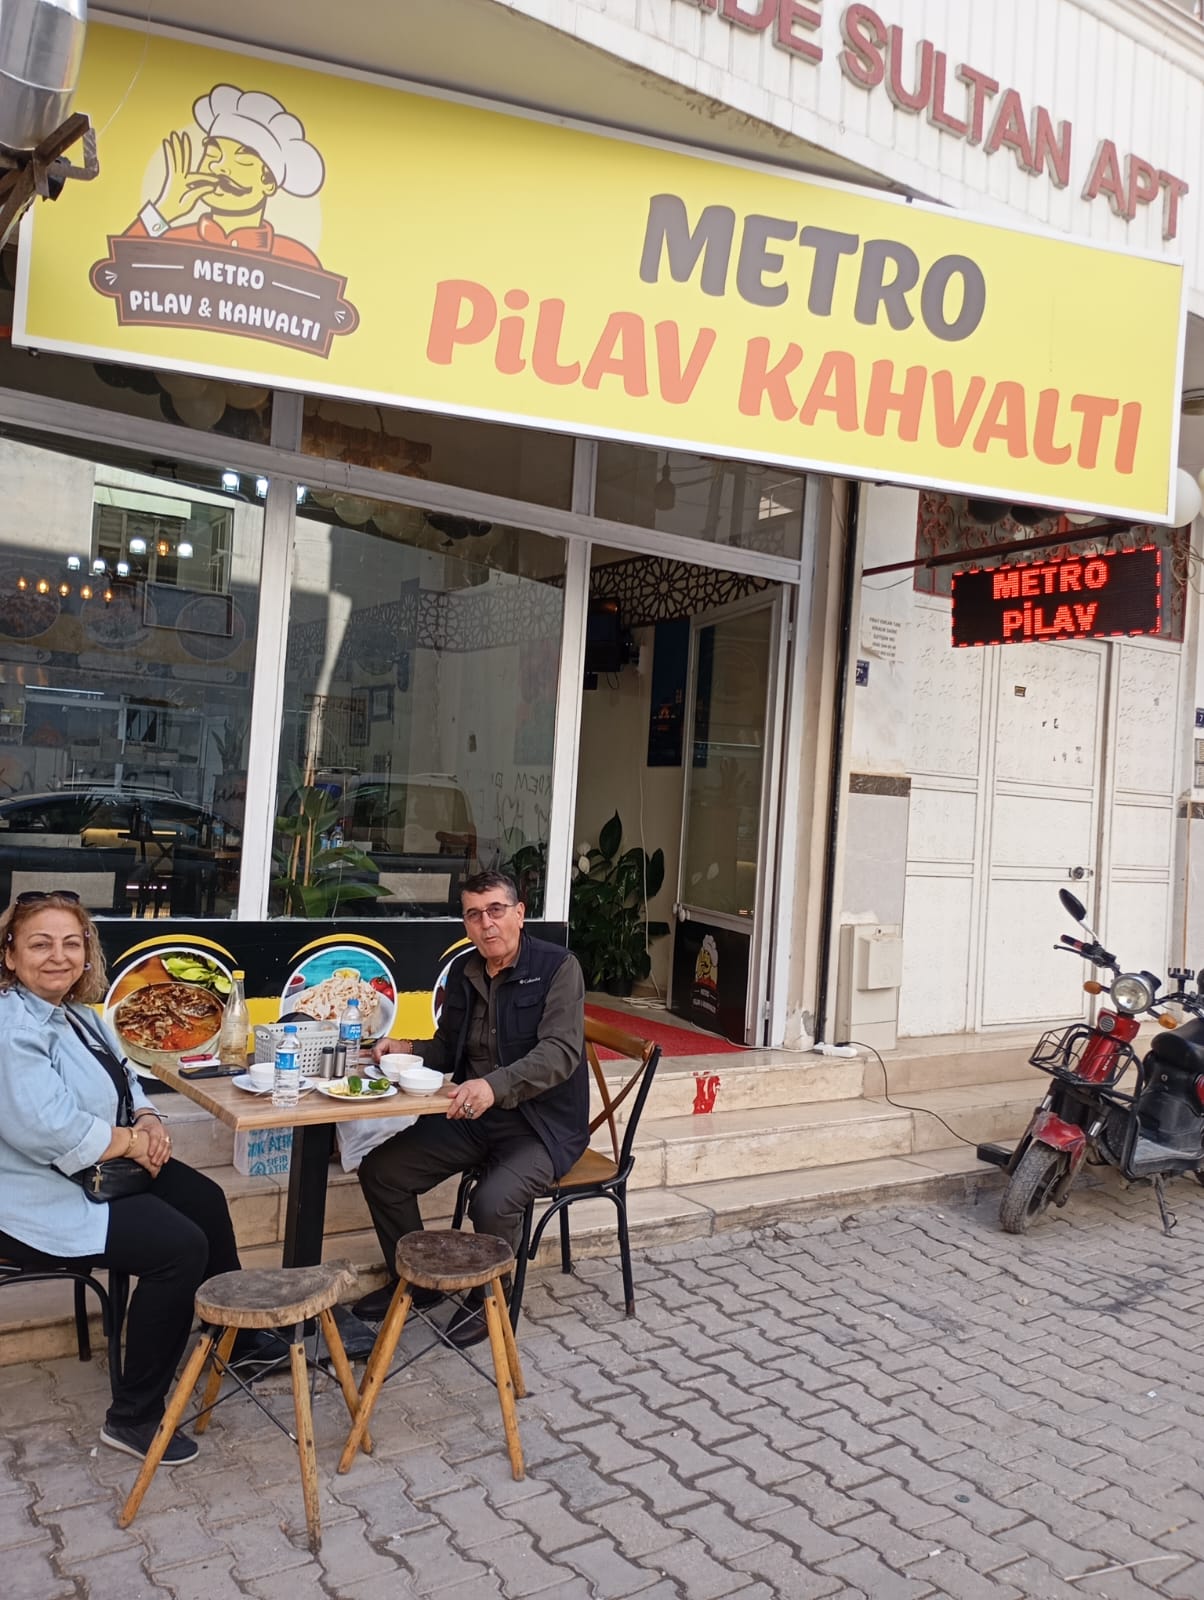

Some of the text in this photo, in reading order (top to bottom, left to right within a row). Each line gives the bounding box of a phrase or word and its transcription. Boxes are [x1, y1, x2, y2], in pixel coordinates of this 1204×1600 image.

[839, 2, 1072, 189] SULTAN
[1081, 139, 1189, 240] APT
[193, 259, 265, 290] METRO
[640, 193, 986, 341] METRO
[198, 298, 212, 318] &
[218, 300, 321, 341] KAHVALTI
[738, 337, 1142, 474] KAHVALTI
[993, 559, 1108, 600] METRO
